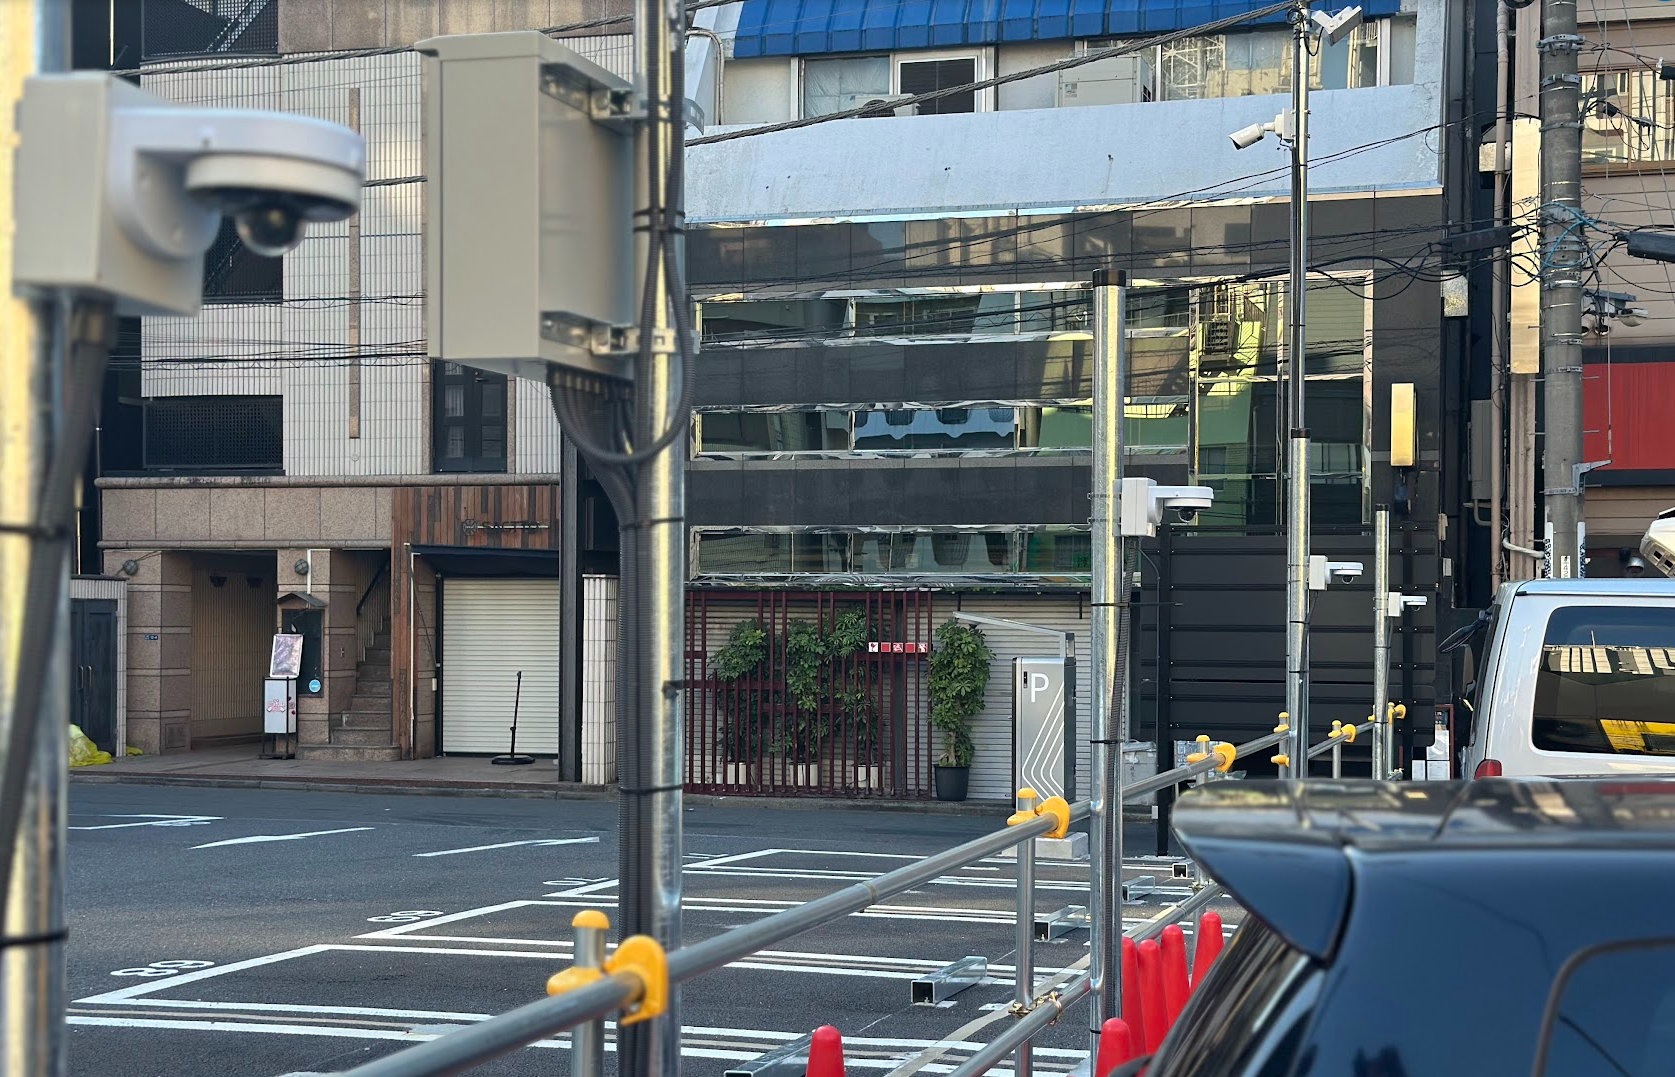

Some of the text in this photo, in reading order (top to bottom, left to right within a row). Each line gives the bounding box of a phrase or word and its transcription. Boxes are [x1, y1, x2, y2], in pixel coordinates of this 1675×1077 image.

[1031, 673, 1049, 702] P
[542, 877, 609, 886] 70
[110, 959, 215, 977] 68
